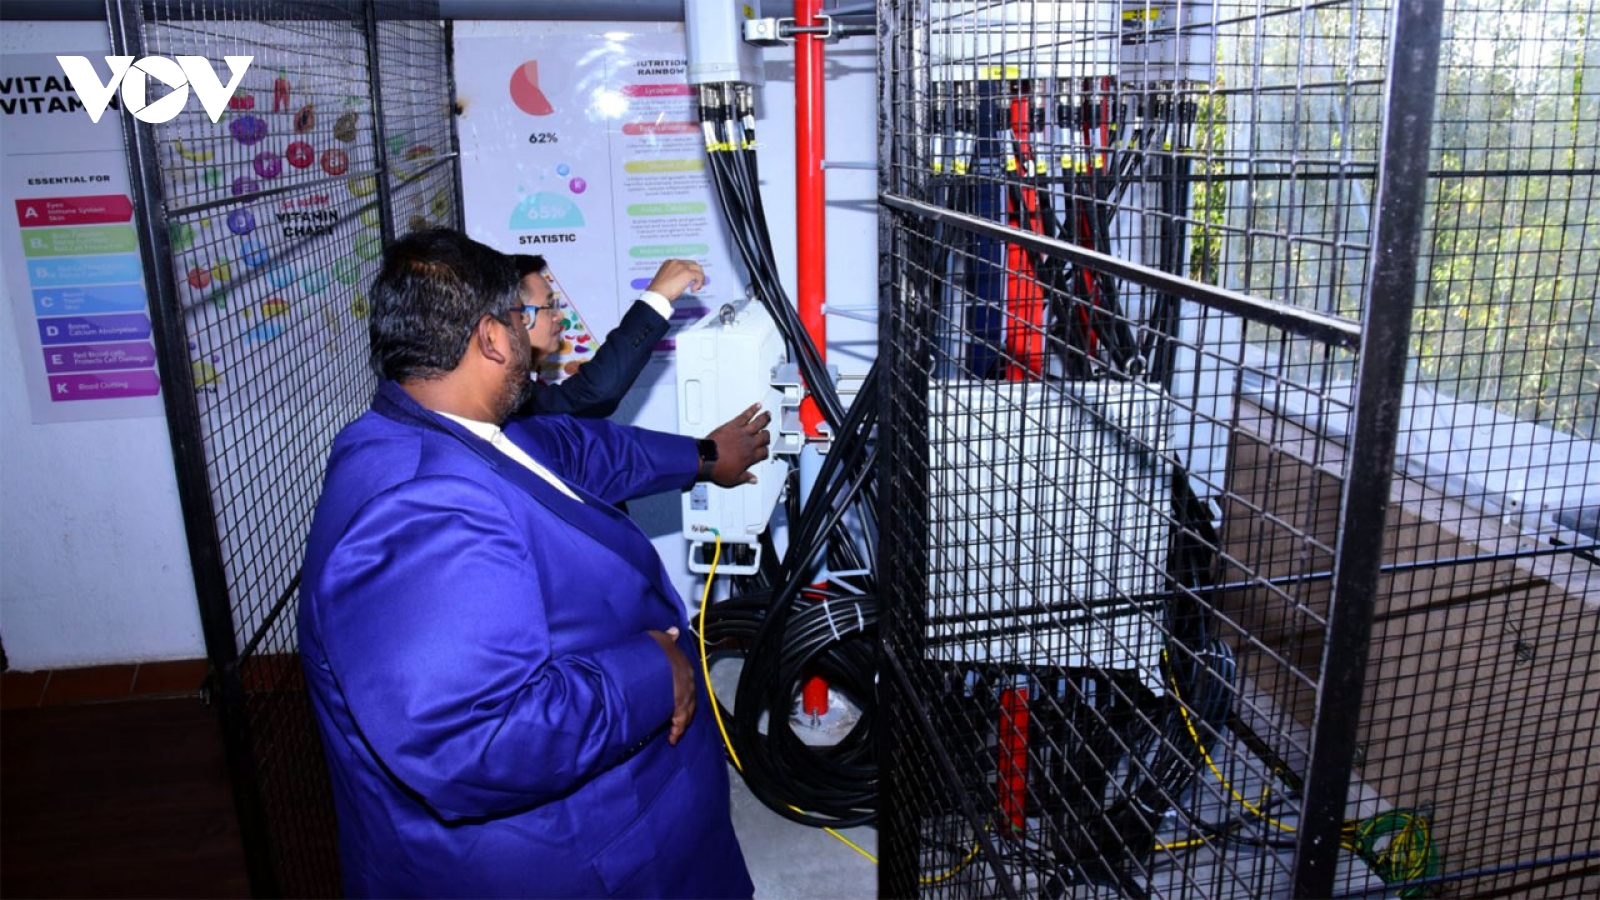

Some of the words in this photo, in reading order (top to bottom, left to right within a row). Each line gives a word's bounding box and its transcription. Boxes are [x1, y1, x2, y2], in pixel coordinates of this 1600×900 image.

[0, 95, 120, 115] VITAMN
[529, 133, 558, 144] 62%
[28, 176, 87, 185] ESSENTIAL
[89, 175, 110, 183] FOR
[25, 206, 39, 218] A
[519, 233, 576, 245] STATISTIC
[40, 296, 54, 308] C
[46, 325, 60, 337] D
[51, 354, 64, 365] E
[56, 383, 69, 394] K
